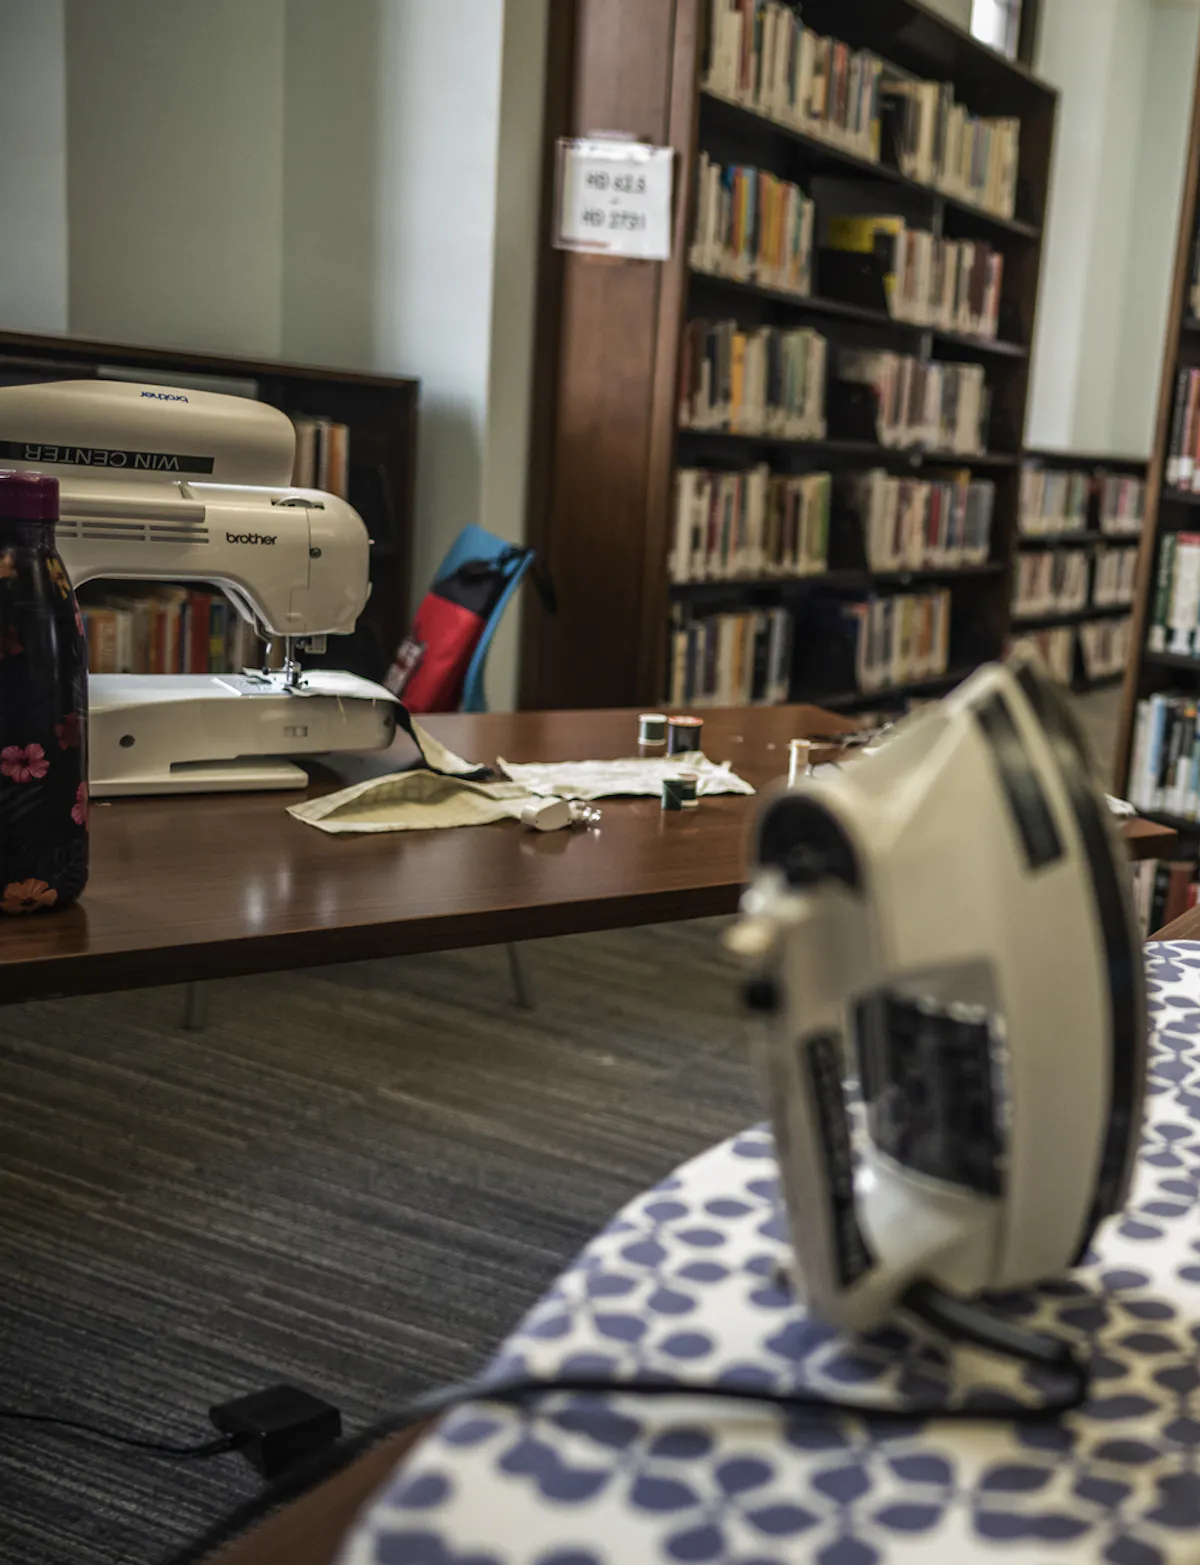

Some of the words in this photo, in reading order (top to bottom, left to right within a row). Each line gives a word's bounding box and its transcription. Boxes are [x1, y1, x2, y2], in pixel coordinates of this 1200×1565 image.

[140, 390, 189, 403] brother
[25, 444, 128, 468] CENTER
[135, 453, 179, 471] WIN
[226, 531, 278, 546] brother
